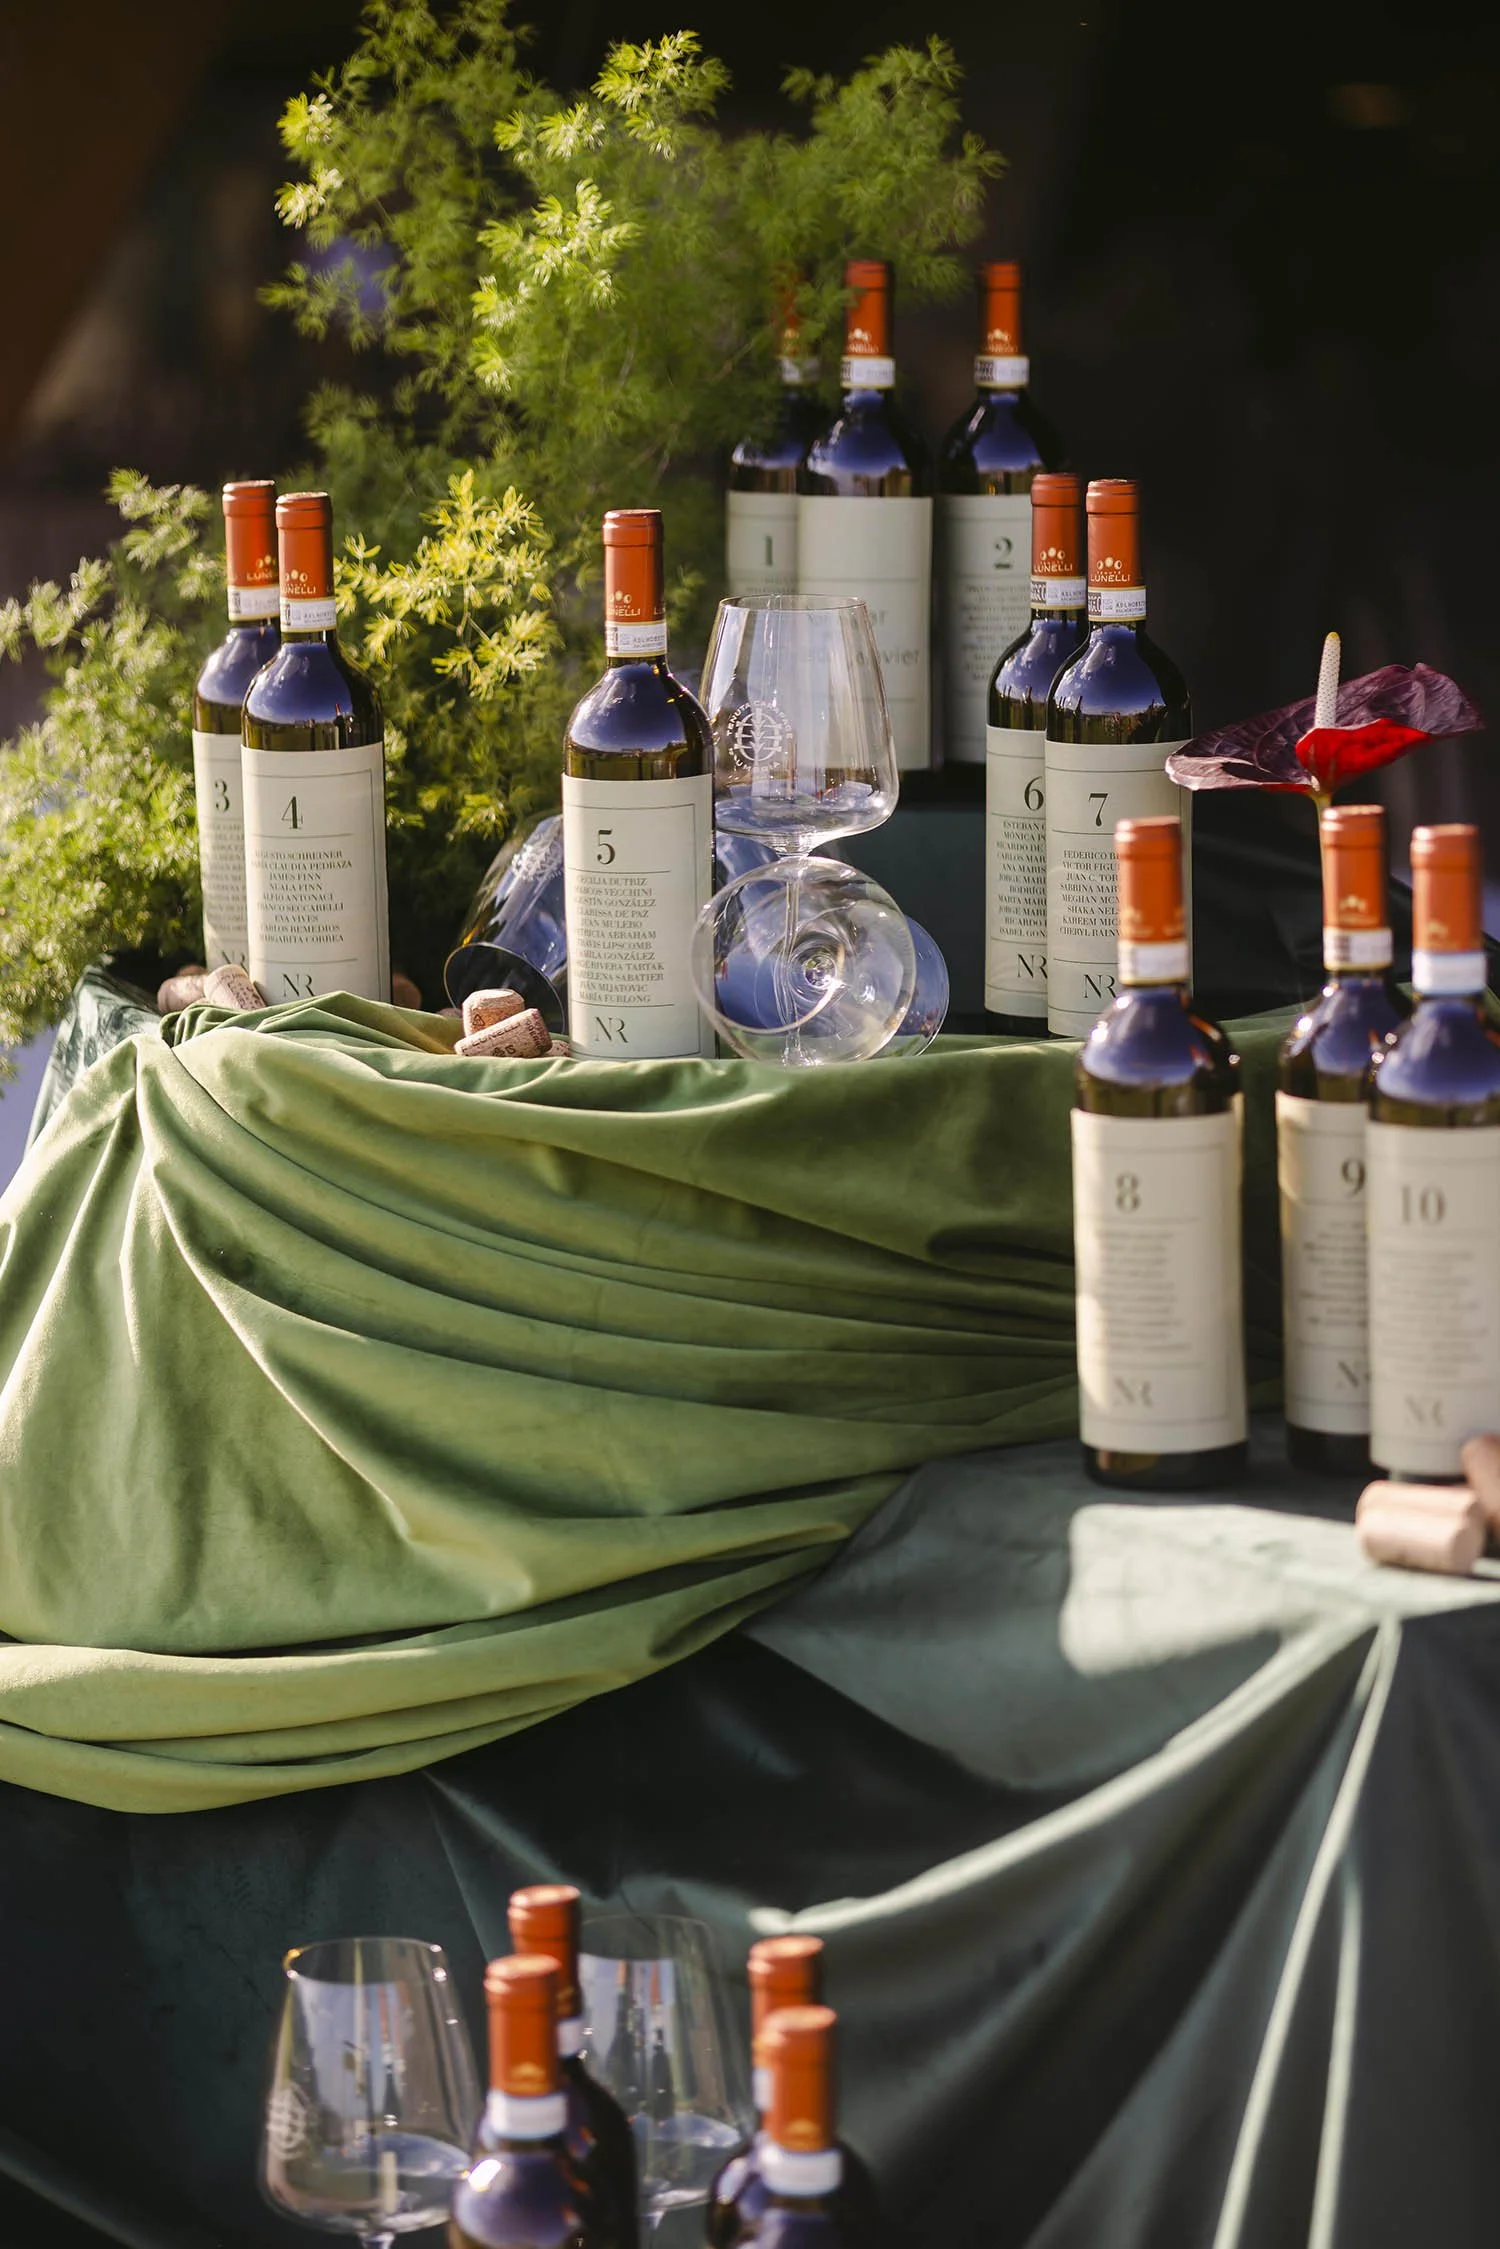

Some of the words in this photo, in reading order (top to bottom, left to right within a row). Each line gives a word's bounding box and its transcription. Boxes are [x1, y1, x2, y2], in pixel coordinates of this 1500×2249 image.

[763, 534, 775, 567] 1
[994, 536, 1013, 570] 2
[1033, 563, 1073, 573] LUNELLI
[1090, 574, 1131, 583] LUNELLI
[281, 585, 317, 595] UNELLI
[726, 702, 751, 737] TENUTA
[214, 778, 230, 813] 3
[1024, 775, 1045, 812] 6
[281, 795, 305, 830] 4
[1088, 793, 1109, 827] 7
[1003, 821, 1040, 831] ESTEBAN
[596, 829, 616, 865] 5
[1063, 850, 1107, 860] FEDERICO
[1002, 863, 1016, 872] ANA
[1063, 861, 1092, 871] VICTOR
[298, 872, 321, 882] FINN
[1066, 872, 1087, 881] JUAN
[298, 882, 322, 892] FINN
[1060, 883, 1093, 893] SABRINA
[1062, 894, 1097, 904] MEGHAN
[615, 909, 629, 919] DE
[631, 909, 649, 918] PAZ
[1067, 905, 1095, 915] SHAKA
[1062, 915, 1097, 925] KAREEM
[608, 930, 657, 940] ABRAHAM
[1060, 927, 1091, 937] CHERYL
[1017, 953, 1047, 979] NR
[282, 973, 317, 998] NR
[1083, 973, 1117, 999] NR
[594, 1016, 629, 1044] NR
[1340, 1157, 1365, 1195] 9
[1115, 1172, 1141, 1212] 8
[1398, 1184, 1446, 1227] 10
